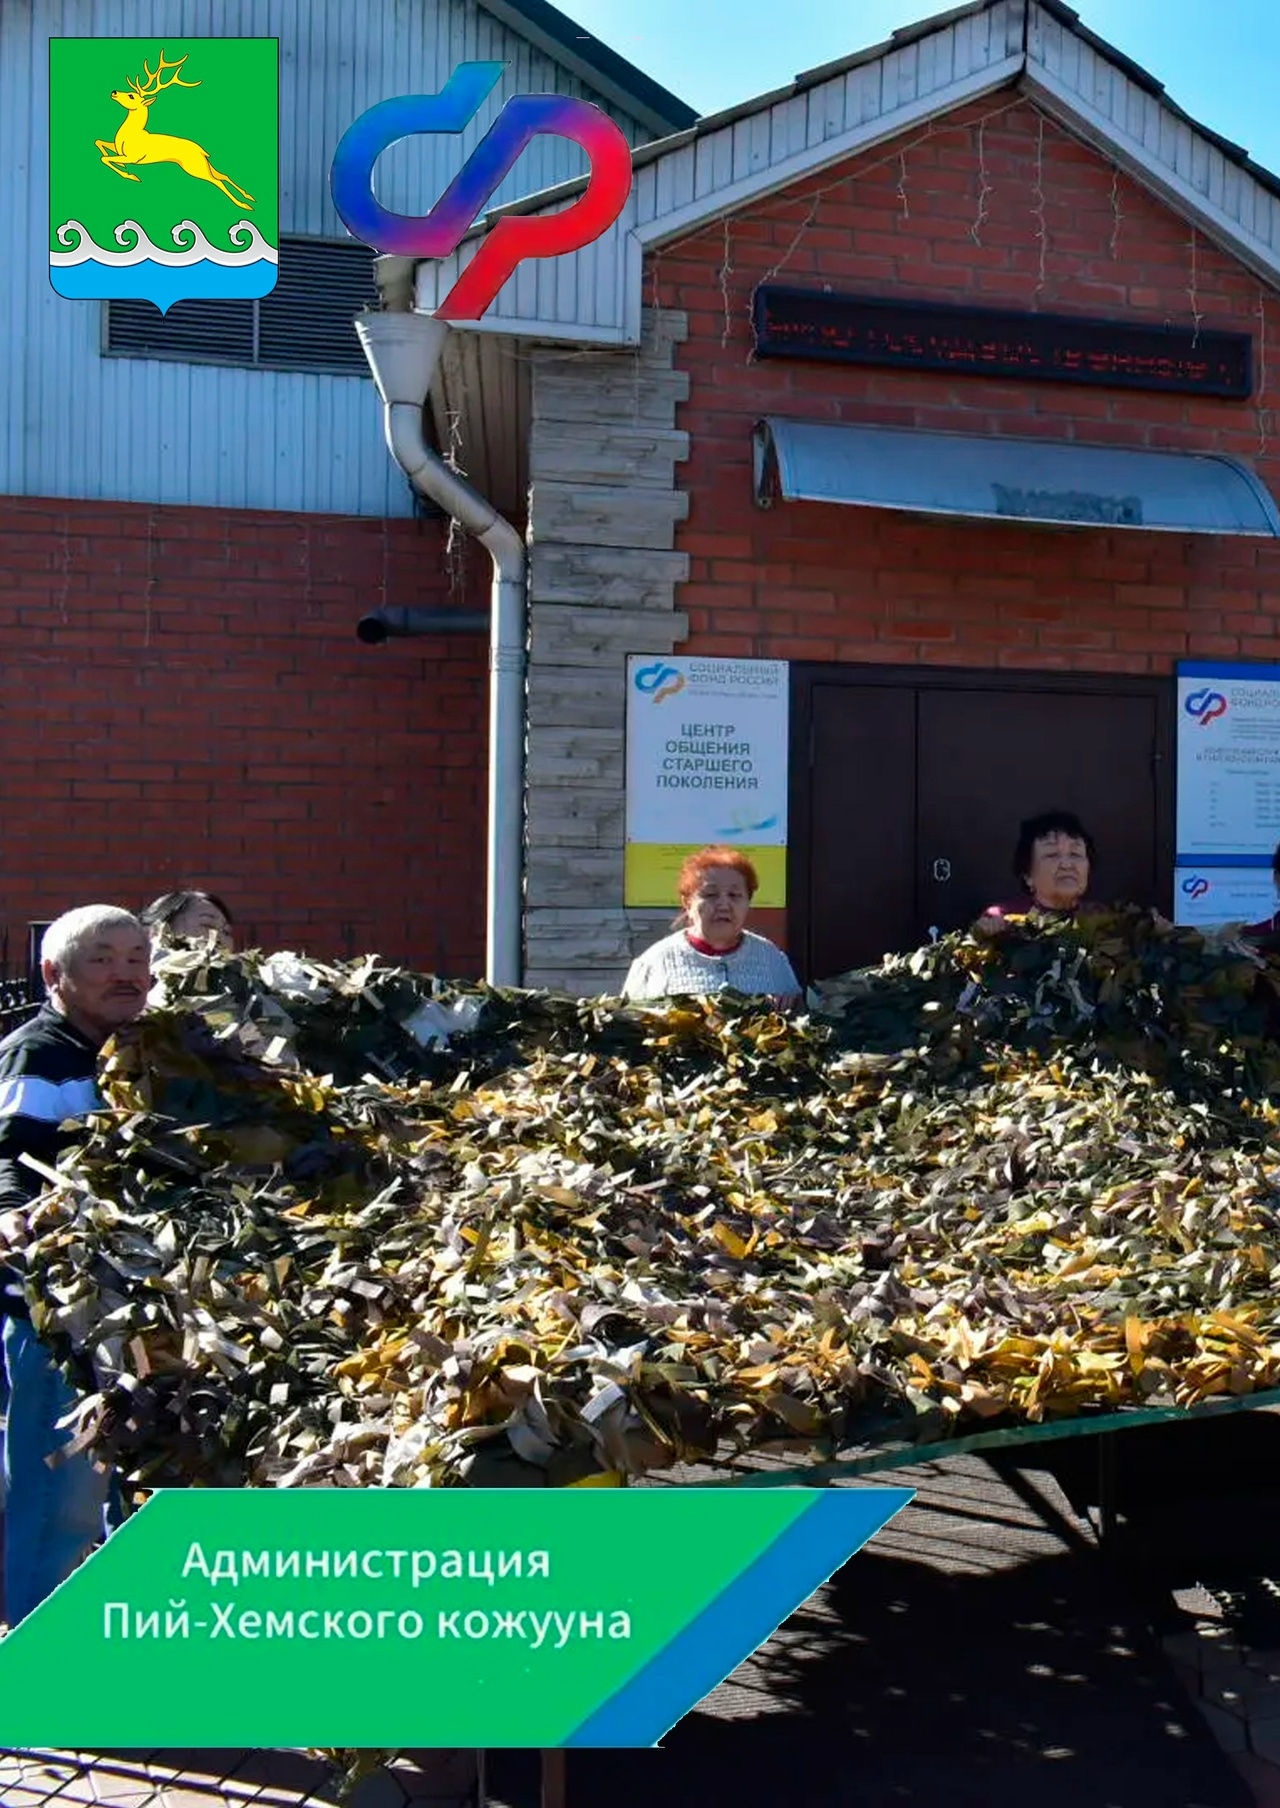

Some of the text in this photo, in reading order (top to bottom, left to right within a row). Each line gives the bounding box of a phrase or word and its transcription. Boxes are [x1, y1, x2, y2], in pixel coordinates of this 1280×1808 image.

[681, 723, 736, 738] ЦЕНТР
[665, 740, 750, 756] ОБЩЕНИЯ
[662, 757, 753, 773] СТАРШЕГО
[656, 774, 759, 790] ПОКОЛЕНИЯ
